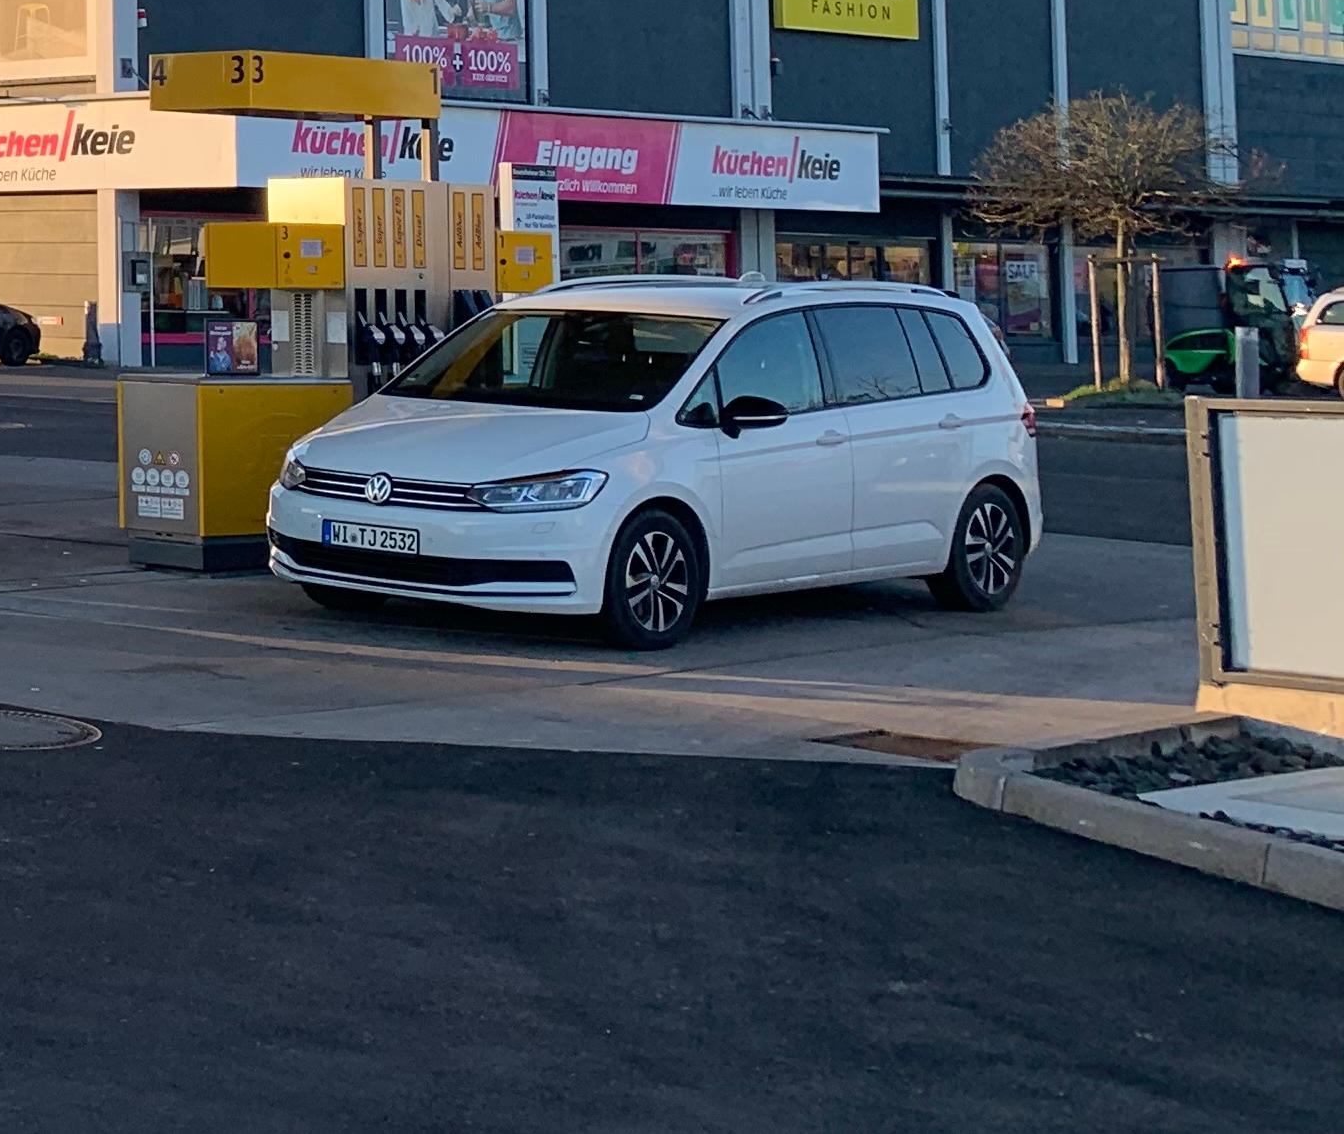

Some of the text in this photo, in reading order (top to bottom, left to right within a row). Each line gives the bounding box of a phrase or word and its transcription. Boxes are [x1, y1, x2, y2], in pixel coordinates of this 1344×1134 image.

[468, 49, 512, 73] 100%
[151, 59, 168, 87] 4
[230, 55, 245, 84] 3
[251, 55, 264, 84] 3
[535, 139, 639, 175] Eingang
[20, 167, 57, 182] Küche
[581, 179, 638, 195] Willkommen
[734, 186, 759, 199] leben
[761, 186, 788, 201] Küche
[279, 225, 289, 240] 3
